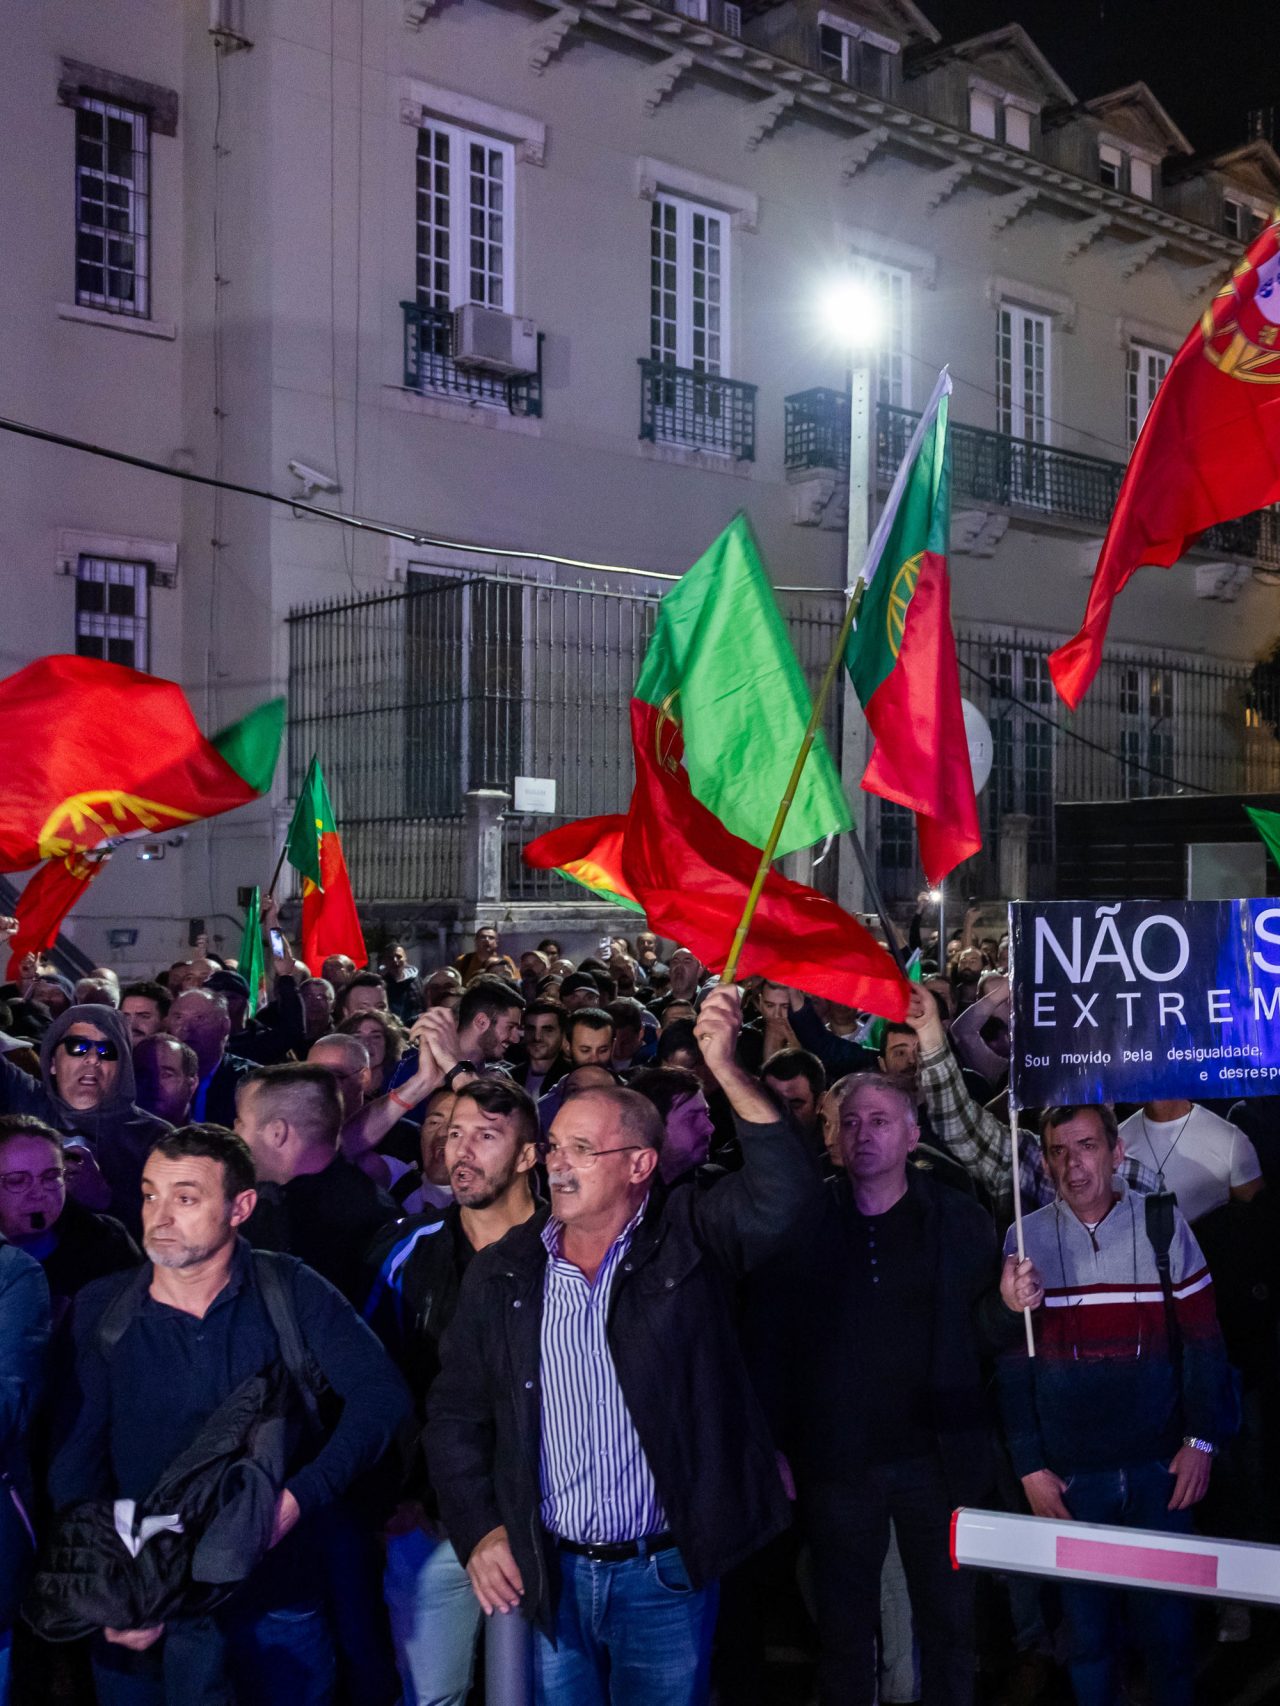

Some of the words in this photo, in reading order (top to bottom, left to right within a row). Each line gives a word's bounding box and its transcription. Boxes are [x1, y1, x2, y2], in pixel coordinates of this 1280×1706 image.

[1034, 902, 1190, 984] NÃO
[1024, 1054, 1050, 1068] Sou
[1060, 1050, 1112, 1065] movido
[1123, 1048, 1153, 1063] pela
[1199, 1070, 1209, 1081] e
